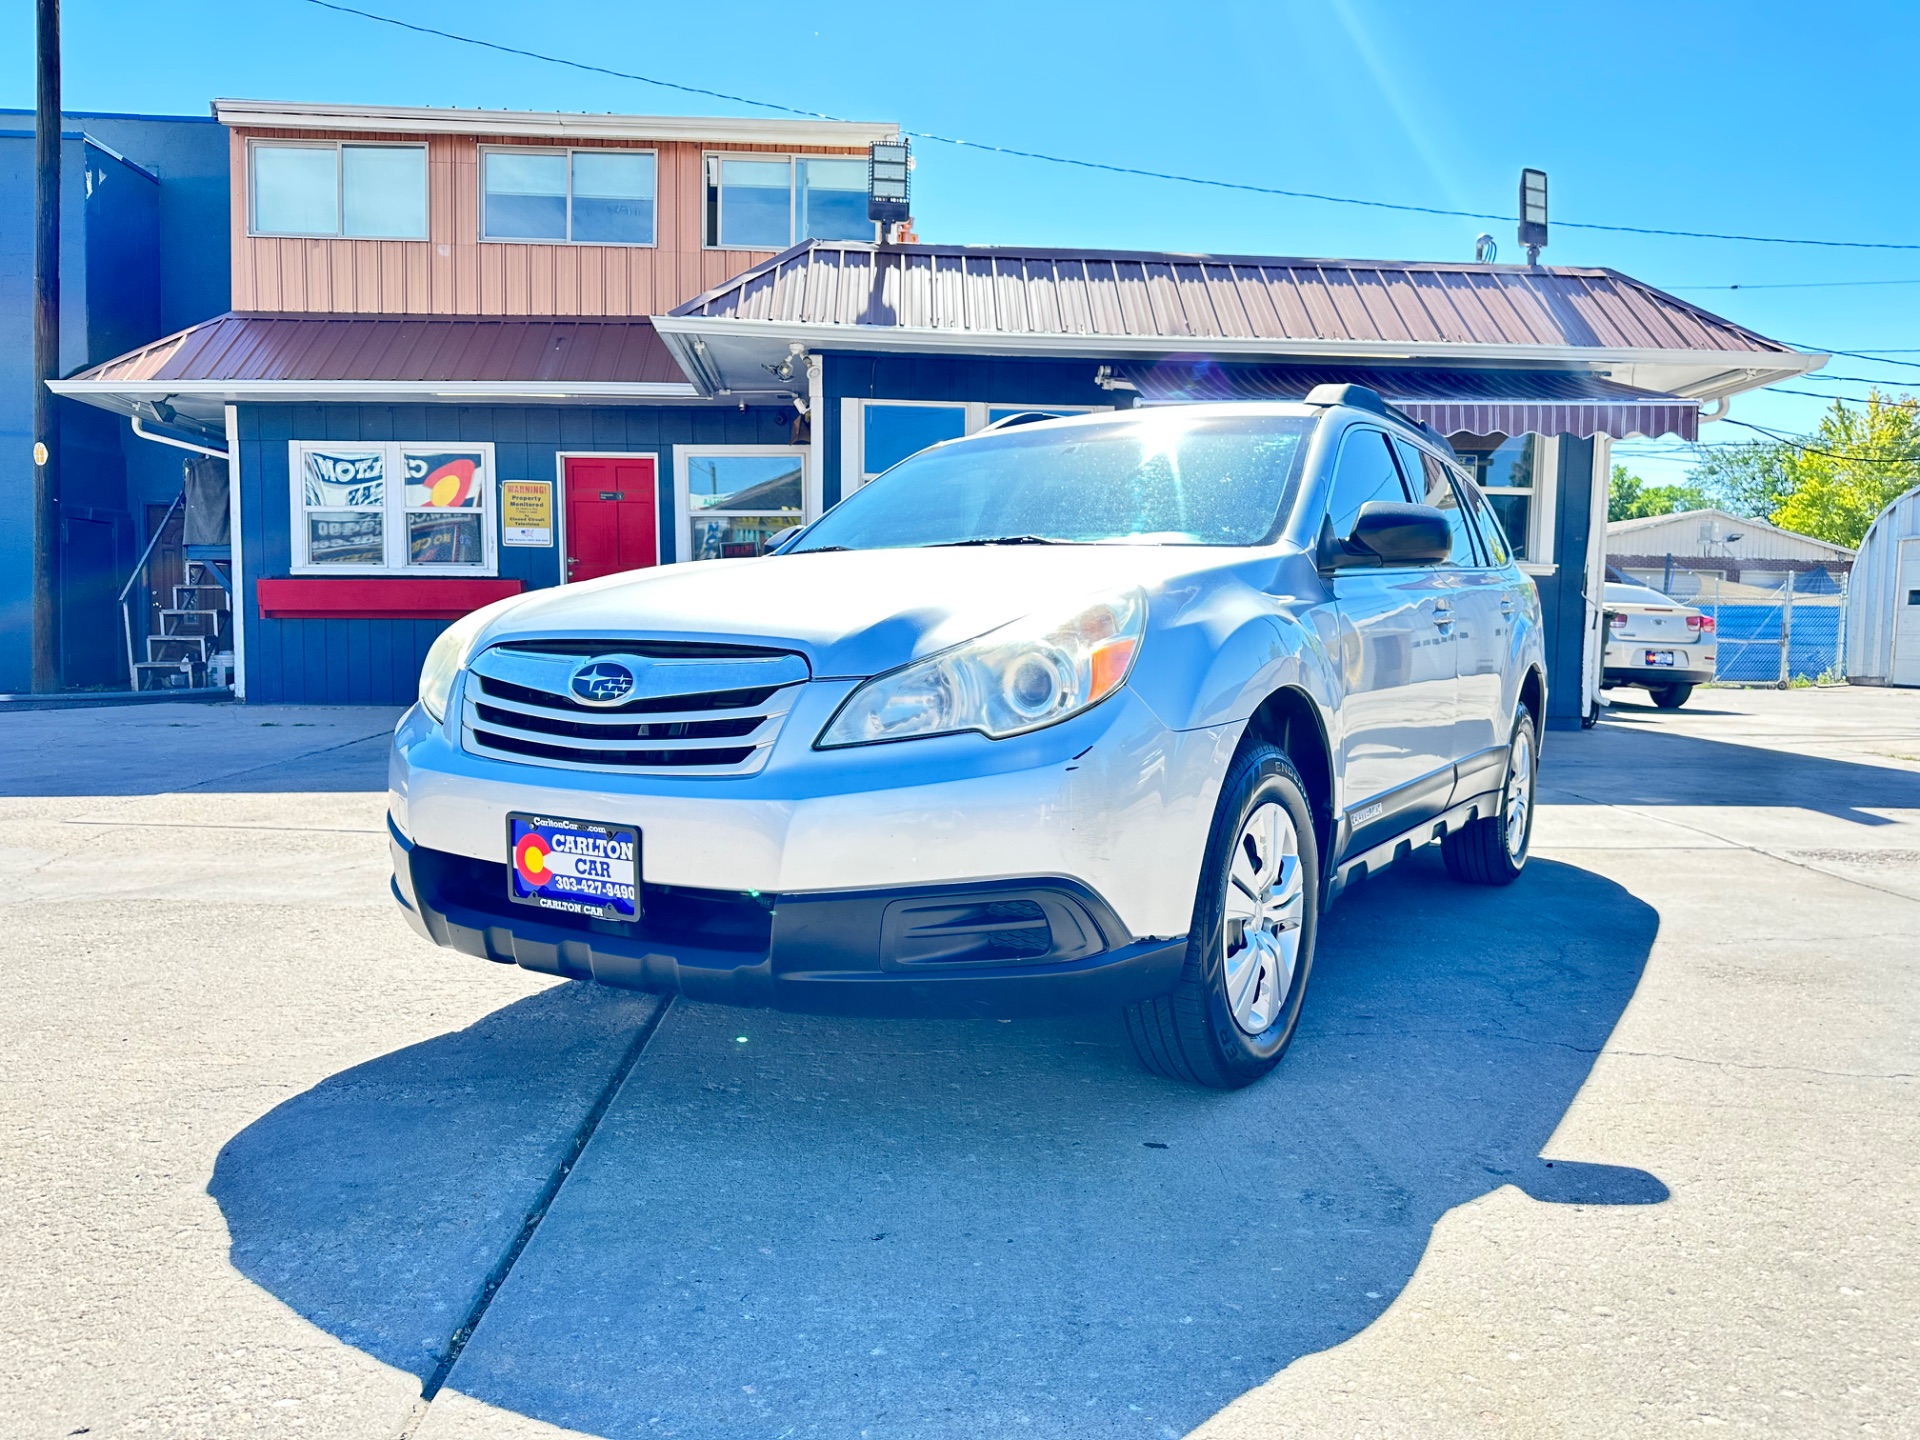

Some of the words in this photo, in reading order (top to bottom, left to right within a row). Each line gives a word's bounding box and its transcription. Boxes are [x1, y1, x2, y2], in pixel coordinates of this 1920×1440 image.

[507, 485, 547, 494] WARNING!
[551, 834, 633, 861] CARLTON
[574, 858, 611, 878] CAR
[555, 876, 635, 900] 303-427-9490
[539, 898, 582, 913] CARLTON
[583, 906, 604, 917] CAR
